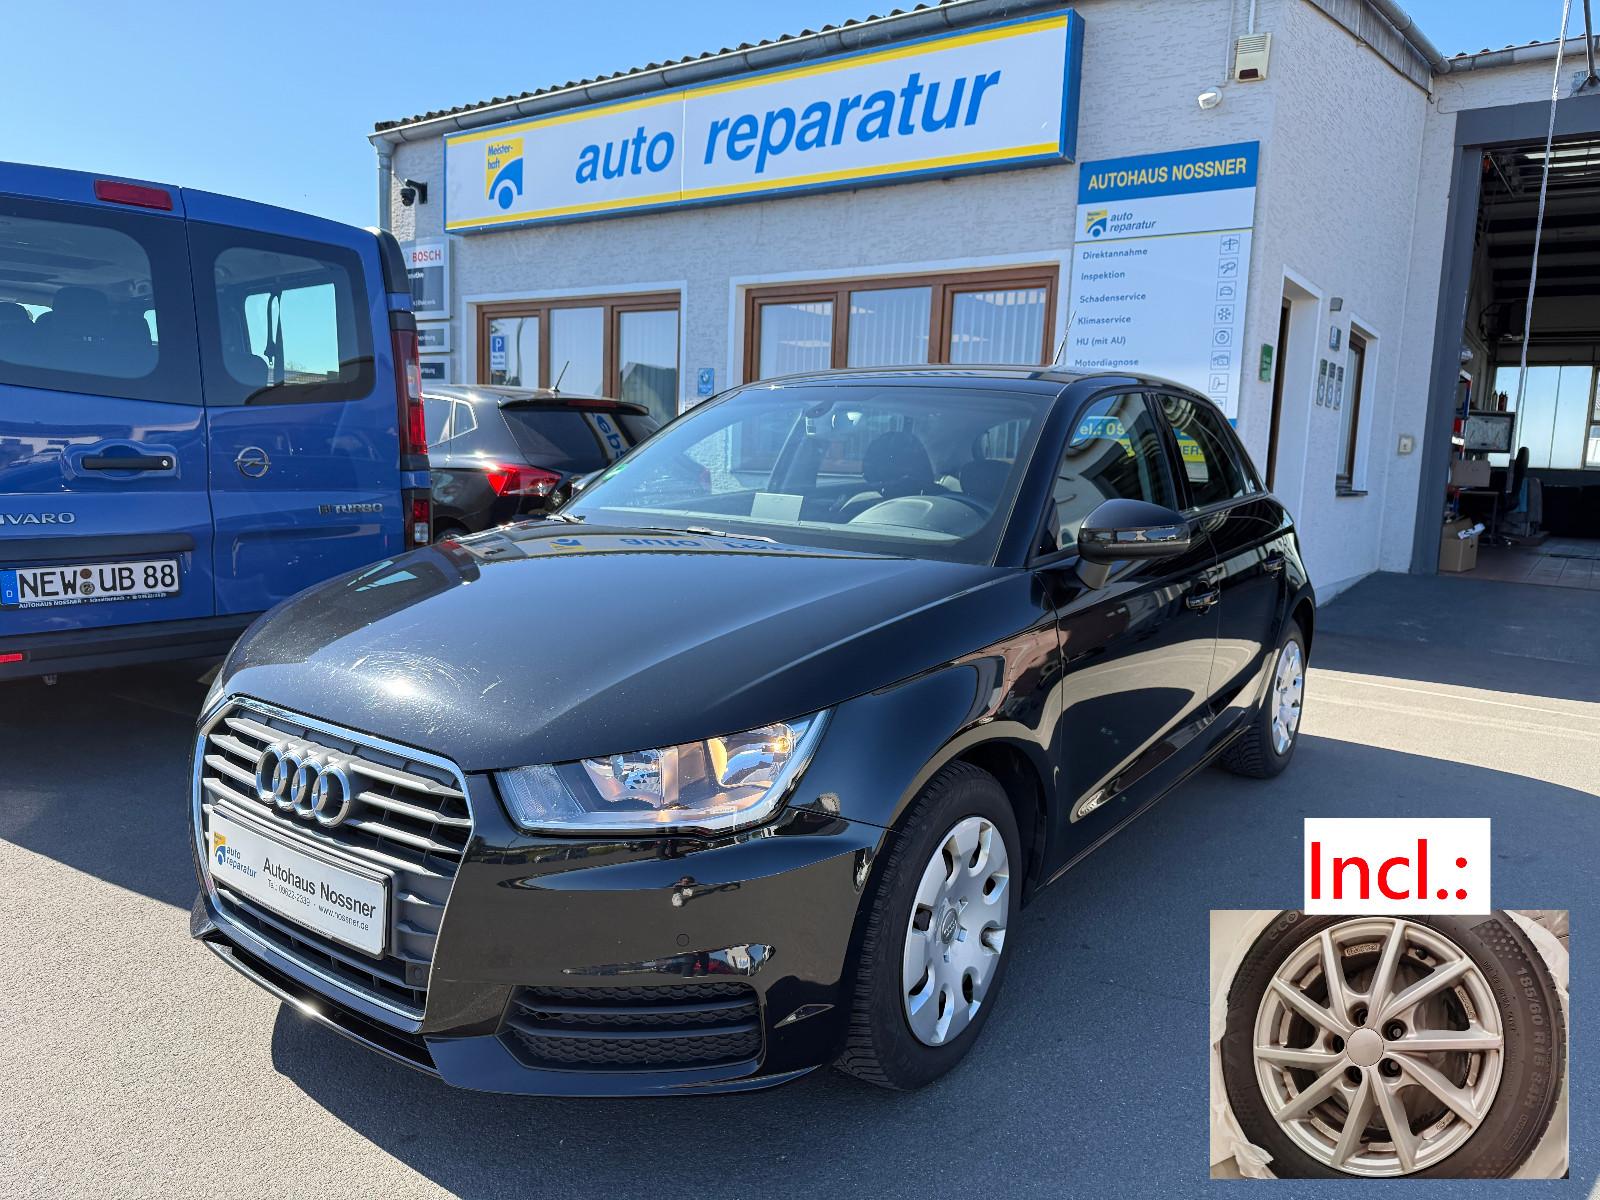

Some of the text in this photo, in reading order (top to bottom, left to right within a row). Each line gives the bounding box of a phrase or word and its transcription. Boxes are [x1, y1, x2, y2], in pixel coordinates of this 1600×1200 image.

[575, 70, 1001, 185] auto reparatur
[1088, 157, 1247, 190] AUTOHAUS NOSSNER
[1110, 211, 1133, 222] auto
[1109, 219, 1157, 234] reparatur
[412, 248, 442, 263] BOSCH
[1082, 248, 1148, 260] Direktannahme
[1080, 270, 1126, 282] Inspektion
[1079, 292, 1147, 304] Schadenservice
[1077, 314, 1132, 326] Klimaservice
[1076, 335, 1126, 347] HU (mit AU)
[1074, 357, 1139, 369] Motordiagnose
[18, 569, 78, 599] NEW
[98, 566, 136, 593] UB
[143, 564, 176, 589] 88
[18, 601, 52, 609] AUTOHAUS
[54, 599, 82, 607] NOSSNER
[226, 846, 241, 860] auto
[226, 856, 257, 879] reparatur
[263, 856, 316, 896] Autohaus
[320, 881, 377, 919] Nossner
